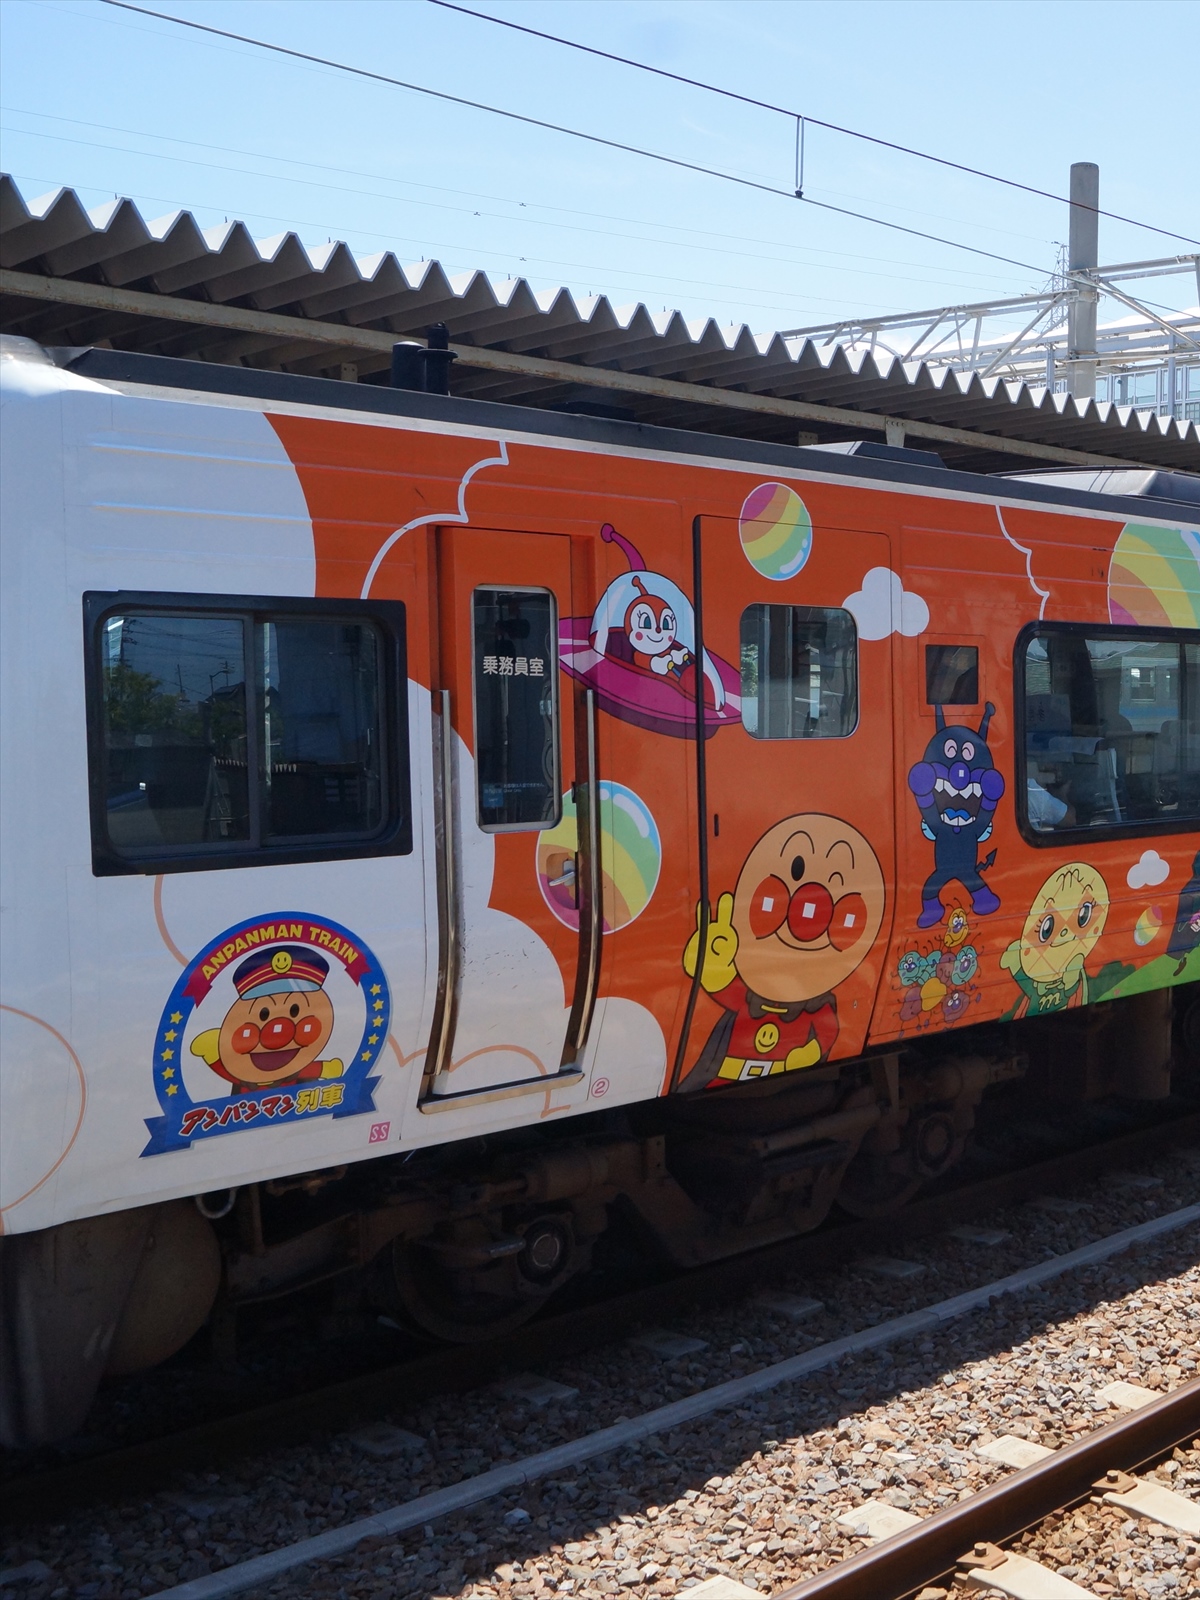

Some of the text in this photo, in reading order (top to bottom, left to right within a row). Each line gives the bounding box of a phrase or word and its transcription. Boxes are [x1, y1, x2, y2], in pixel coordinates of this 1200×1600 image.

[482, 655, 545, 677] 乗務員室
[201, 924, 358, 980] ANPANMAN TRAIN
[179, 1084, 344, 1136] アンパンマン列車
[371, 1124, 388, 1141] SS
